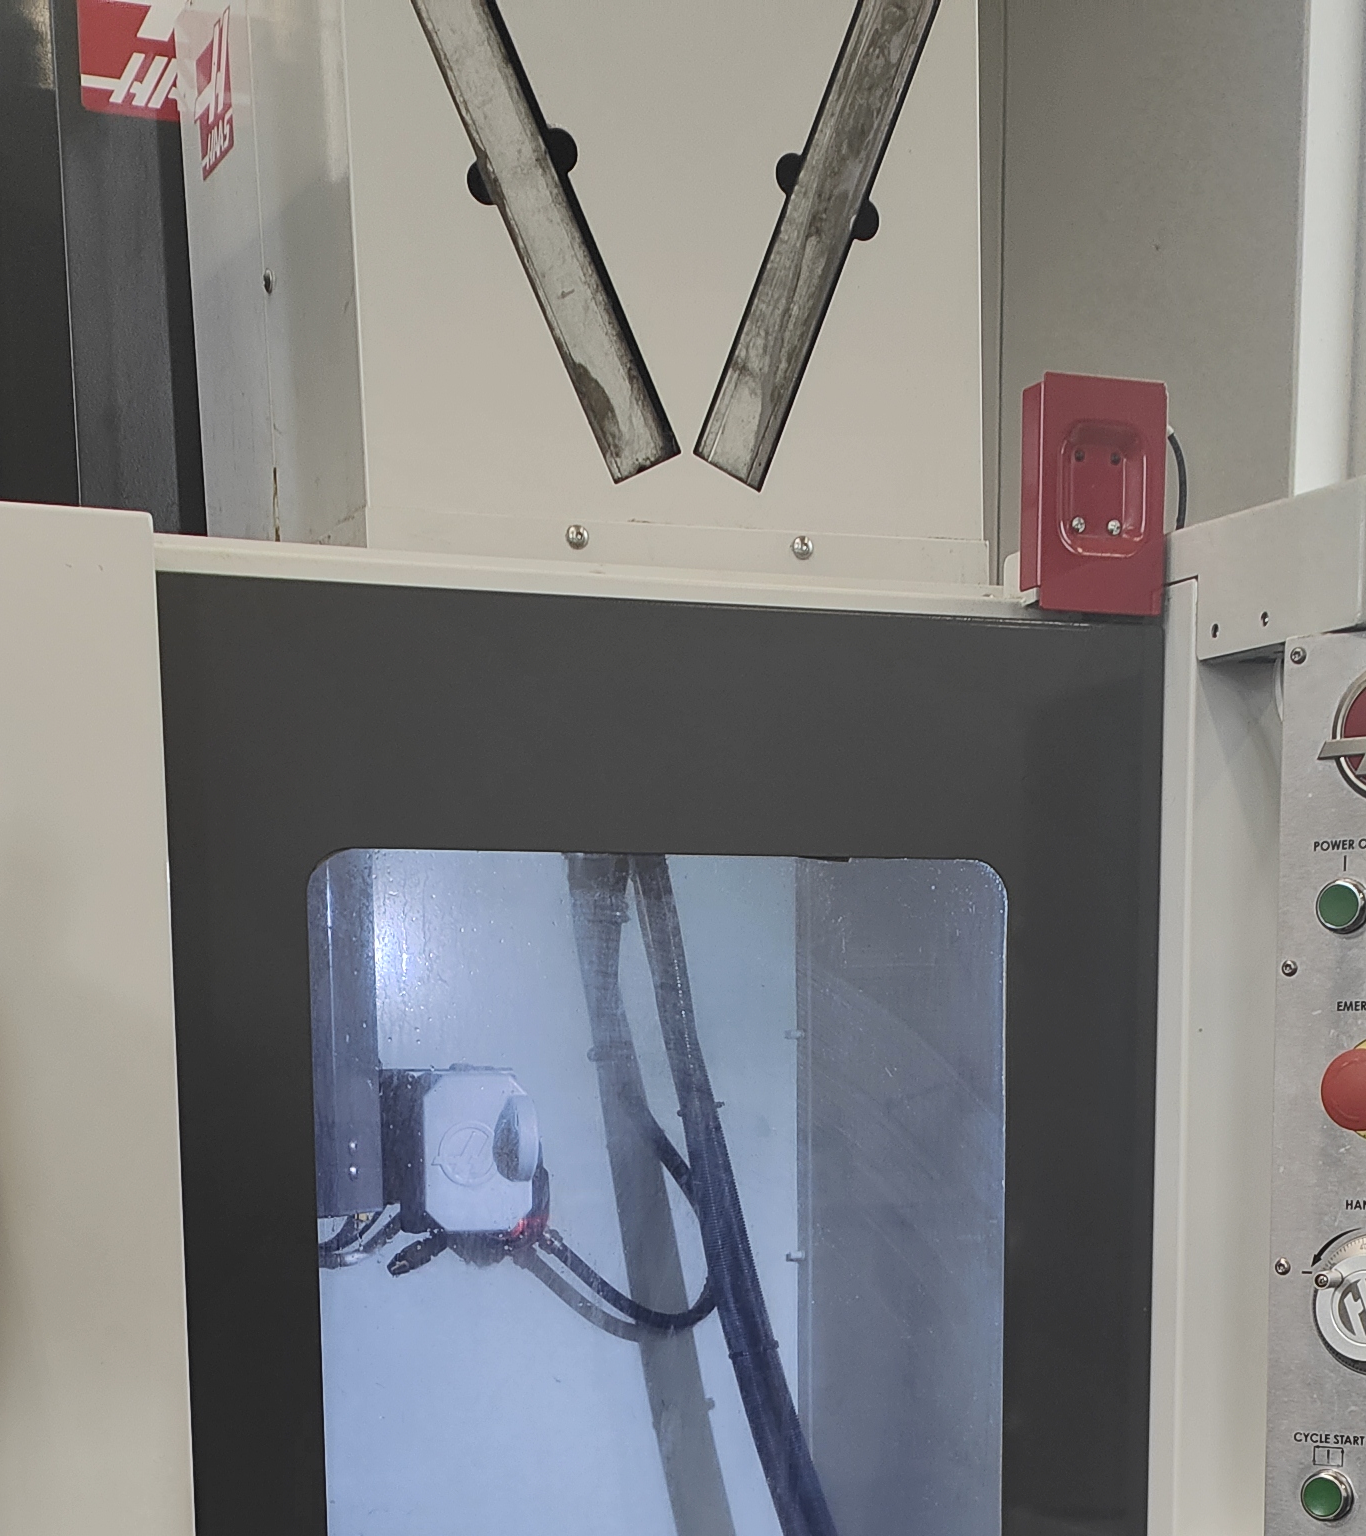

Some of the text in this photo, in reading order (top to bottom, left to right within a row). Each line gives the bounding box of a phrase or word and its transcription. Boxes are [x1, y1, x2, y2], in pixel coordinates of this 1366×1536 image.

[1313, 838, 1355, 852] POWER
[1293, 1431, 1365, 1446] CYCLE START
